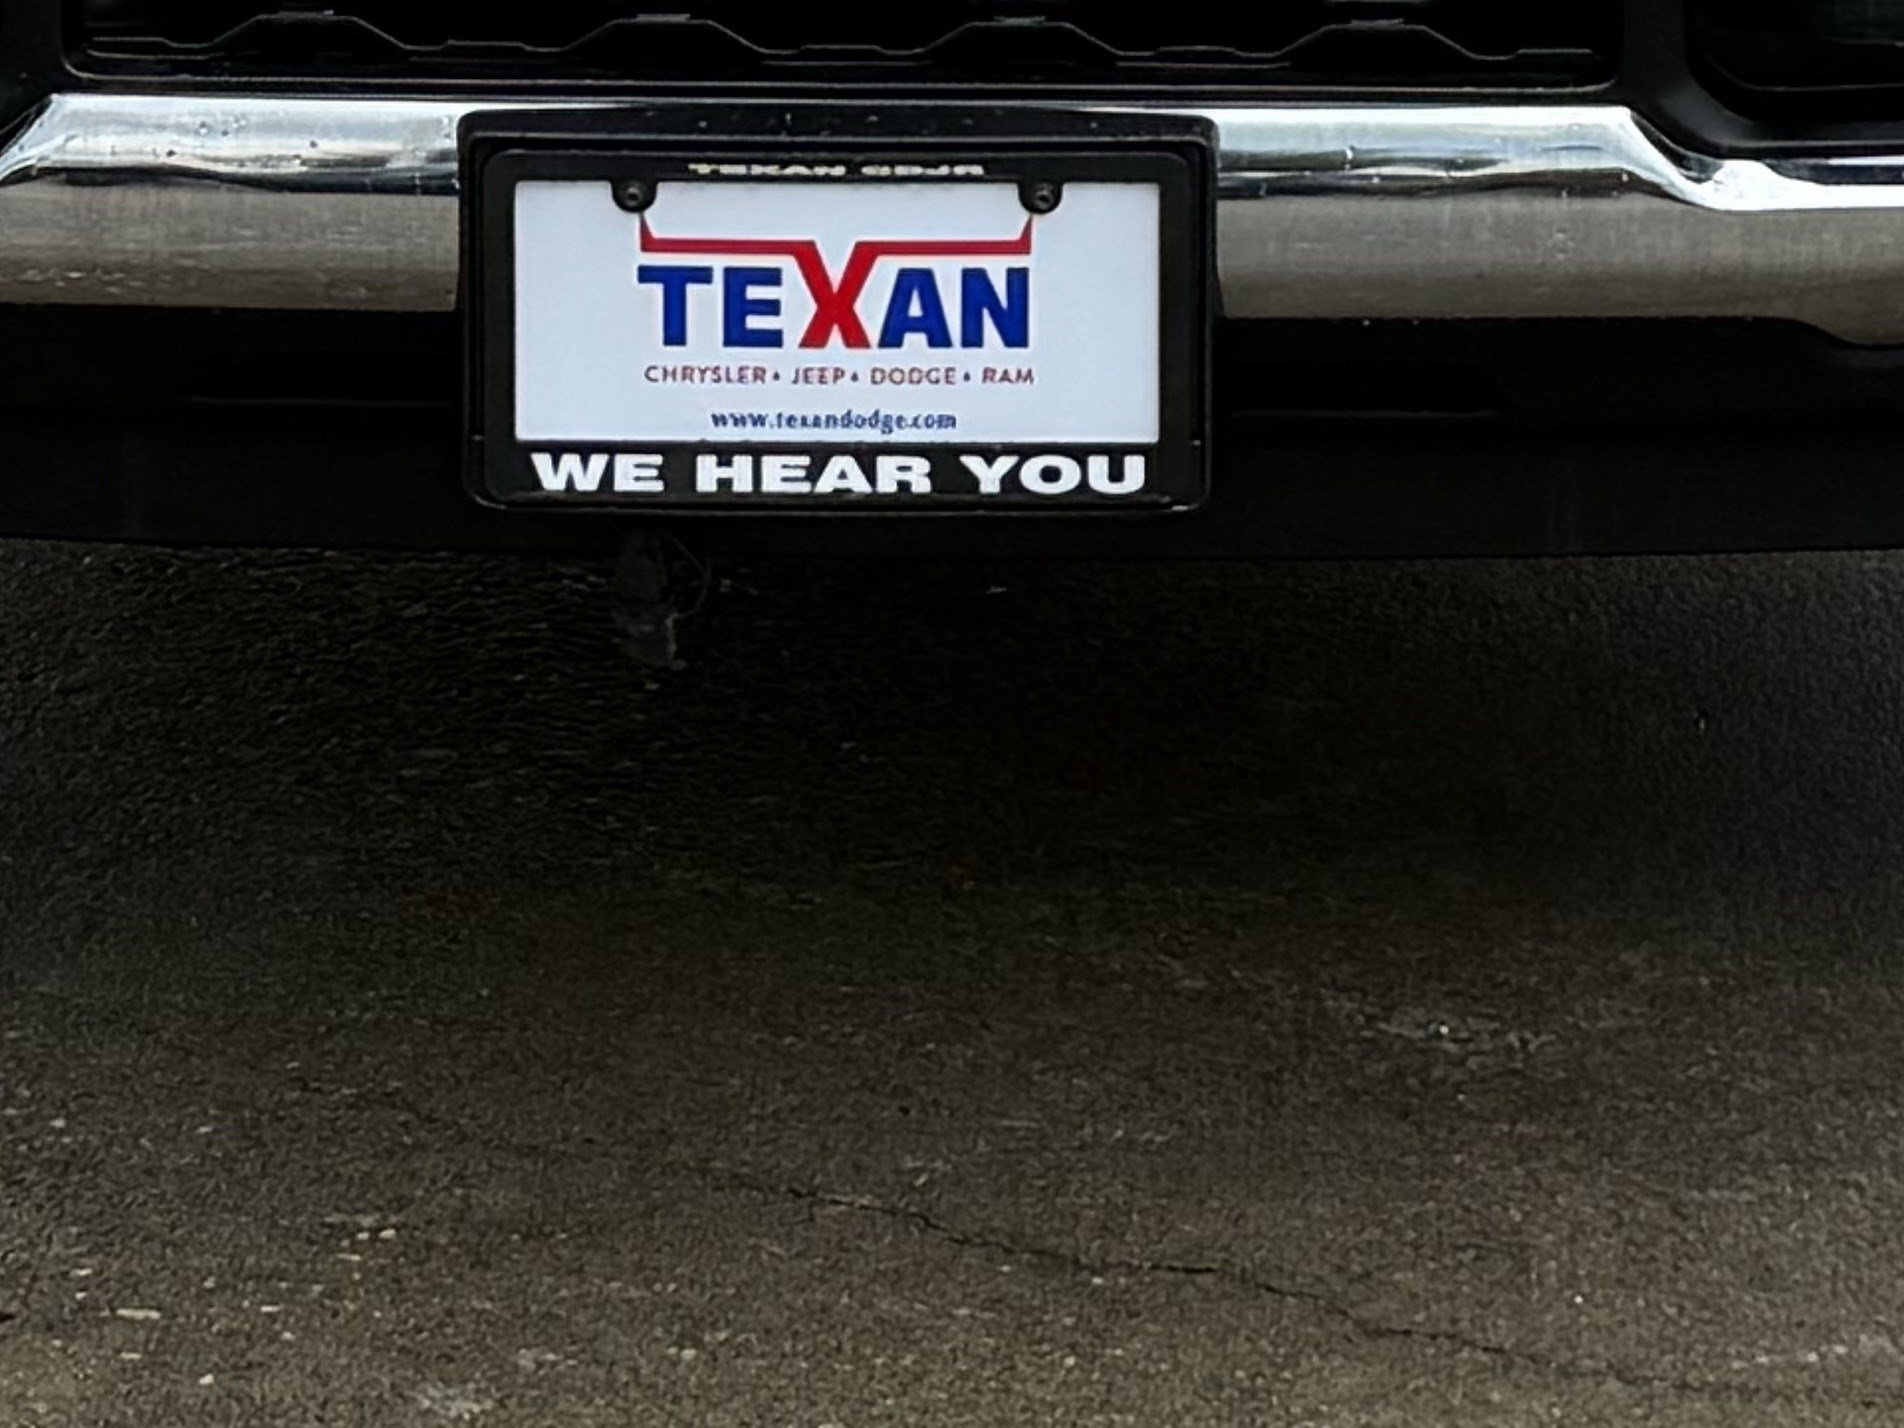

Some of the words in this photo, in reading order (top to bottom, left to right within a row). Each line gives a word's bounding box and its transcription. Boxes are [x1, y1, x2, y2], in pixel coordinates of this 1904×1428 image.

[687, 163, 846, 176] TEXAN
[637, 240, 1032, 349] TEXAN
[643, 363, 768, 386] CHRYSLER
[791, 365, 846, 386] JEEP
[869, 366, 958, 387] DODGE
[980, 367, 1036, 387] RAM
[709, 408, 958, 436] www.texandodge.com
[530, 452, 665, 495] WE
[695, 452, 934, 495] HEAR
[959, 452, 1147, 496] YOU
